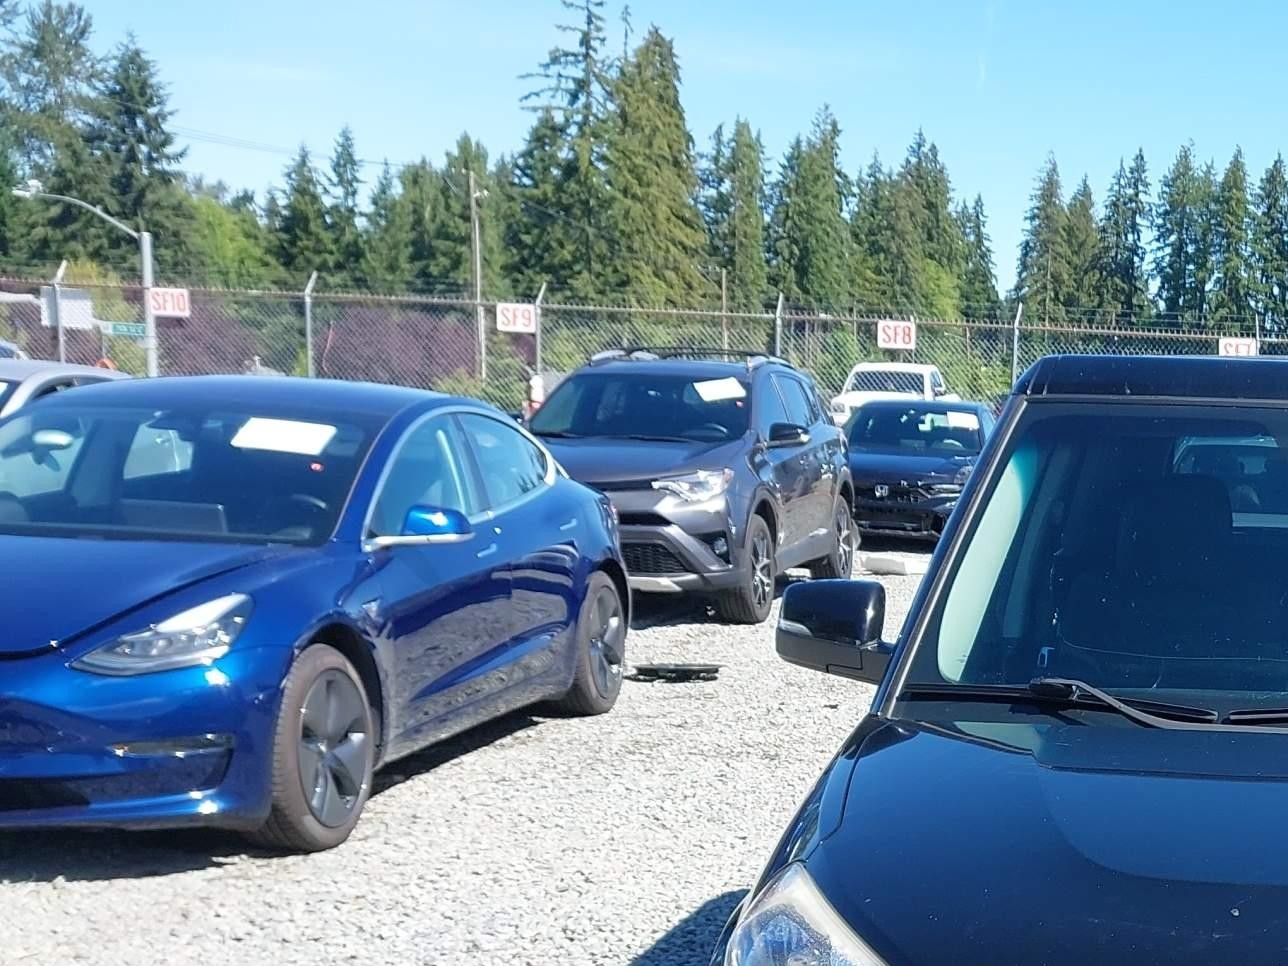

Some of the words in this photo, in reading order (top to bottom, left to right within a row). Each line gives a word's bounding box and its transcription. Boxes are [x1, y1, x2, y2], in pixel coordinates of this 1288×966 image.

[151, 291, 187, 312] SF10
[500, 306, 532, 327] SF9
[882, 325, 912, 345] SF8
